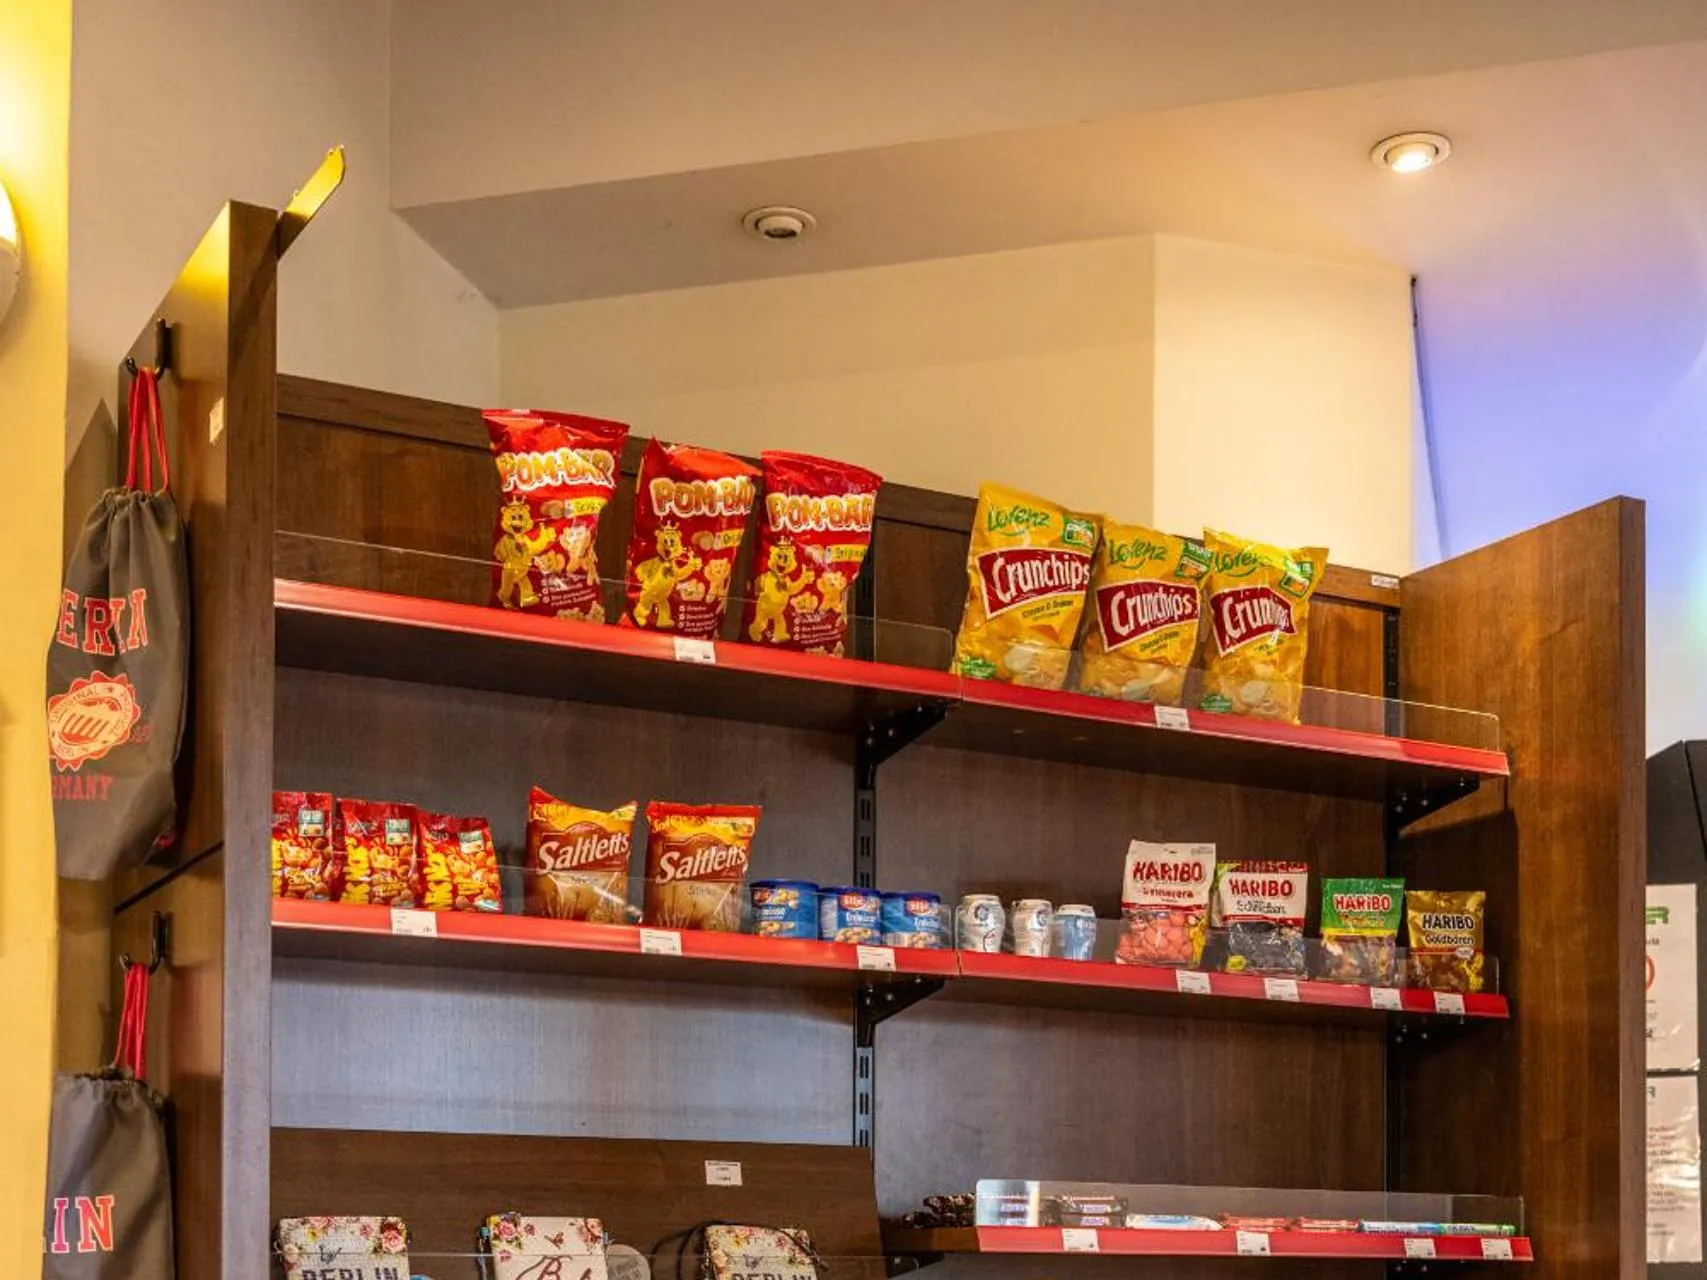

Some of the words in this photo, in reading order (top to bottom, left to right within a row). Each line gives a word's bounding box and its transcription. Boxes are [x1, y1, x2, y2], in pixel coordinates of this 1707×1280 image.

[496, 448, 616, 491] POM-BAR
[1108, 537, 1168, 565] Lorenz
[991, 553, 1090, 603] Crunchips
[1111, 586, 1193, 636] Crunchips
[536, 832, 630, 875] Saltletts
[655, 845, 749, 884] Saltletts
[1133, 860, 1204, 883] HARIBO
[1229, 879, 1294, 897] HARIBO
[1334, 894, 1391, 911] HARIBO
[1422, 914, 1474, 930] HARIBO
